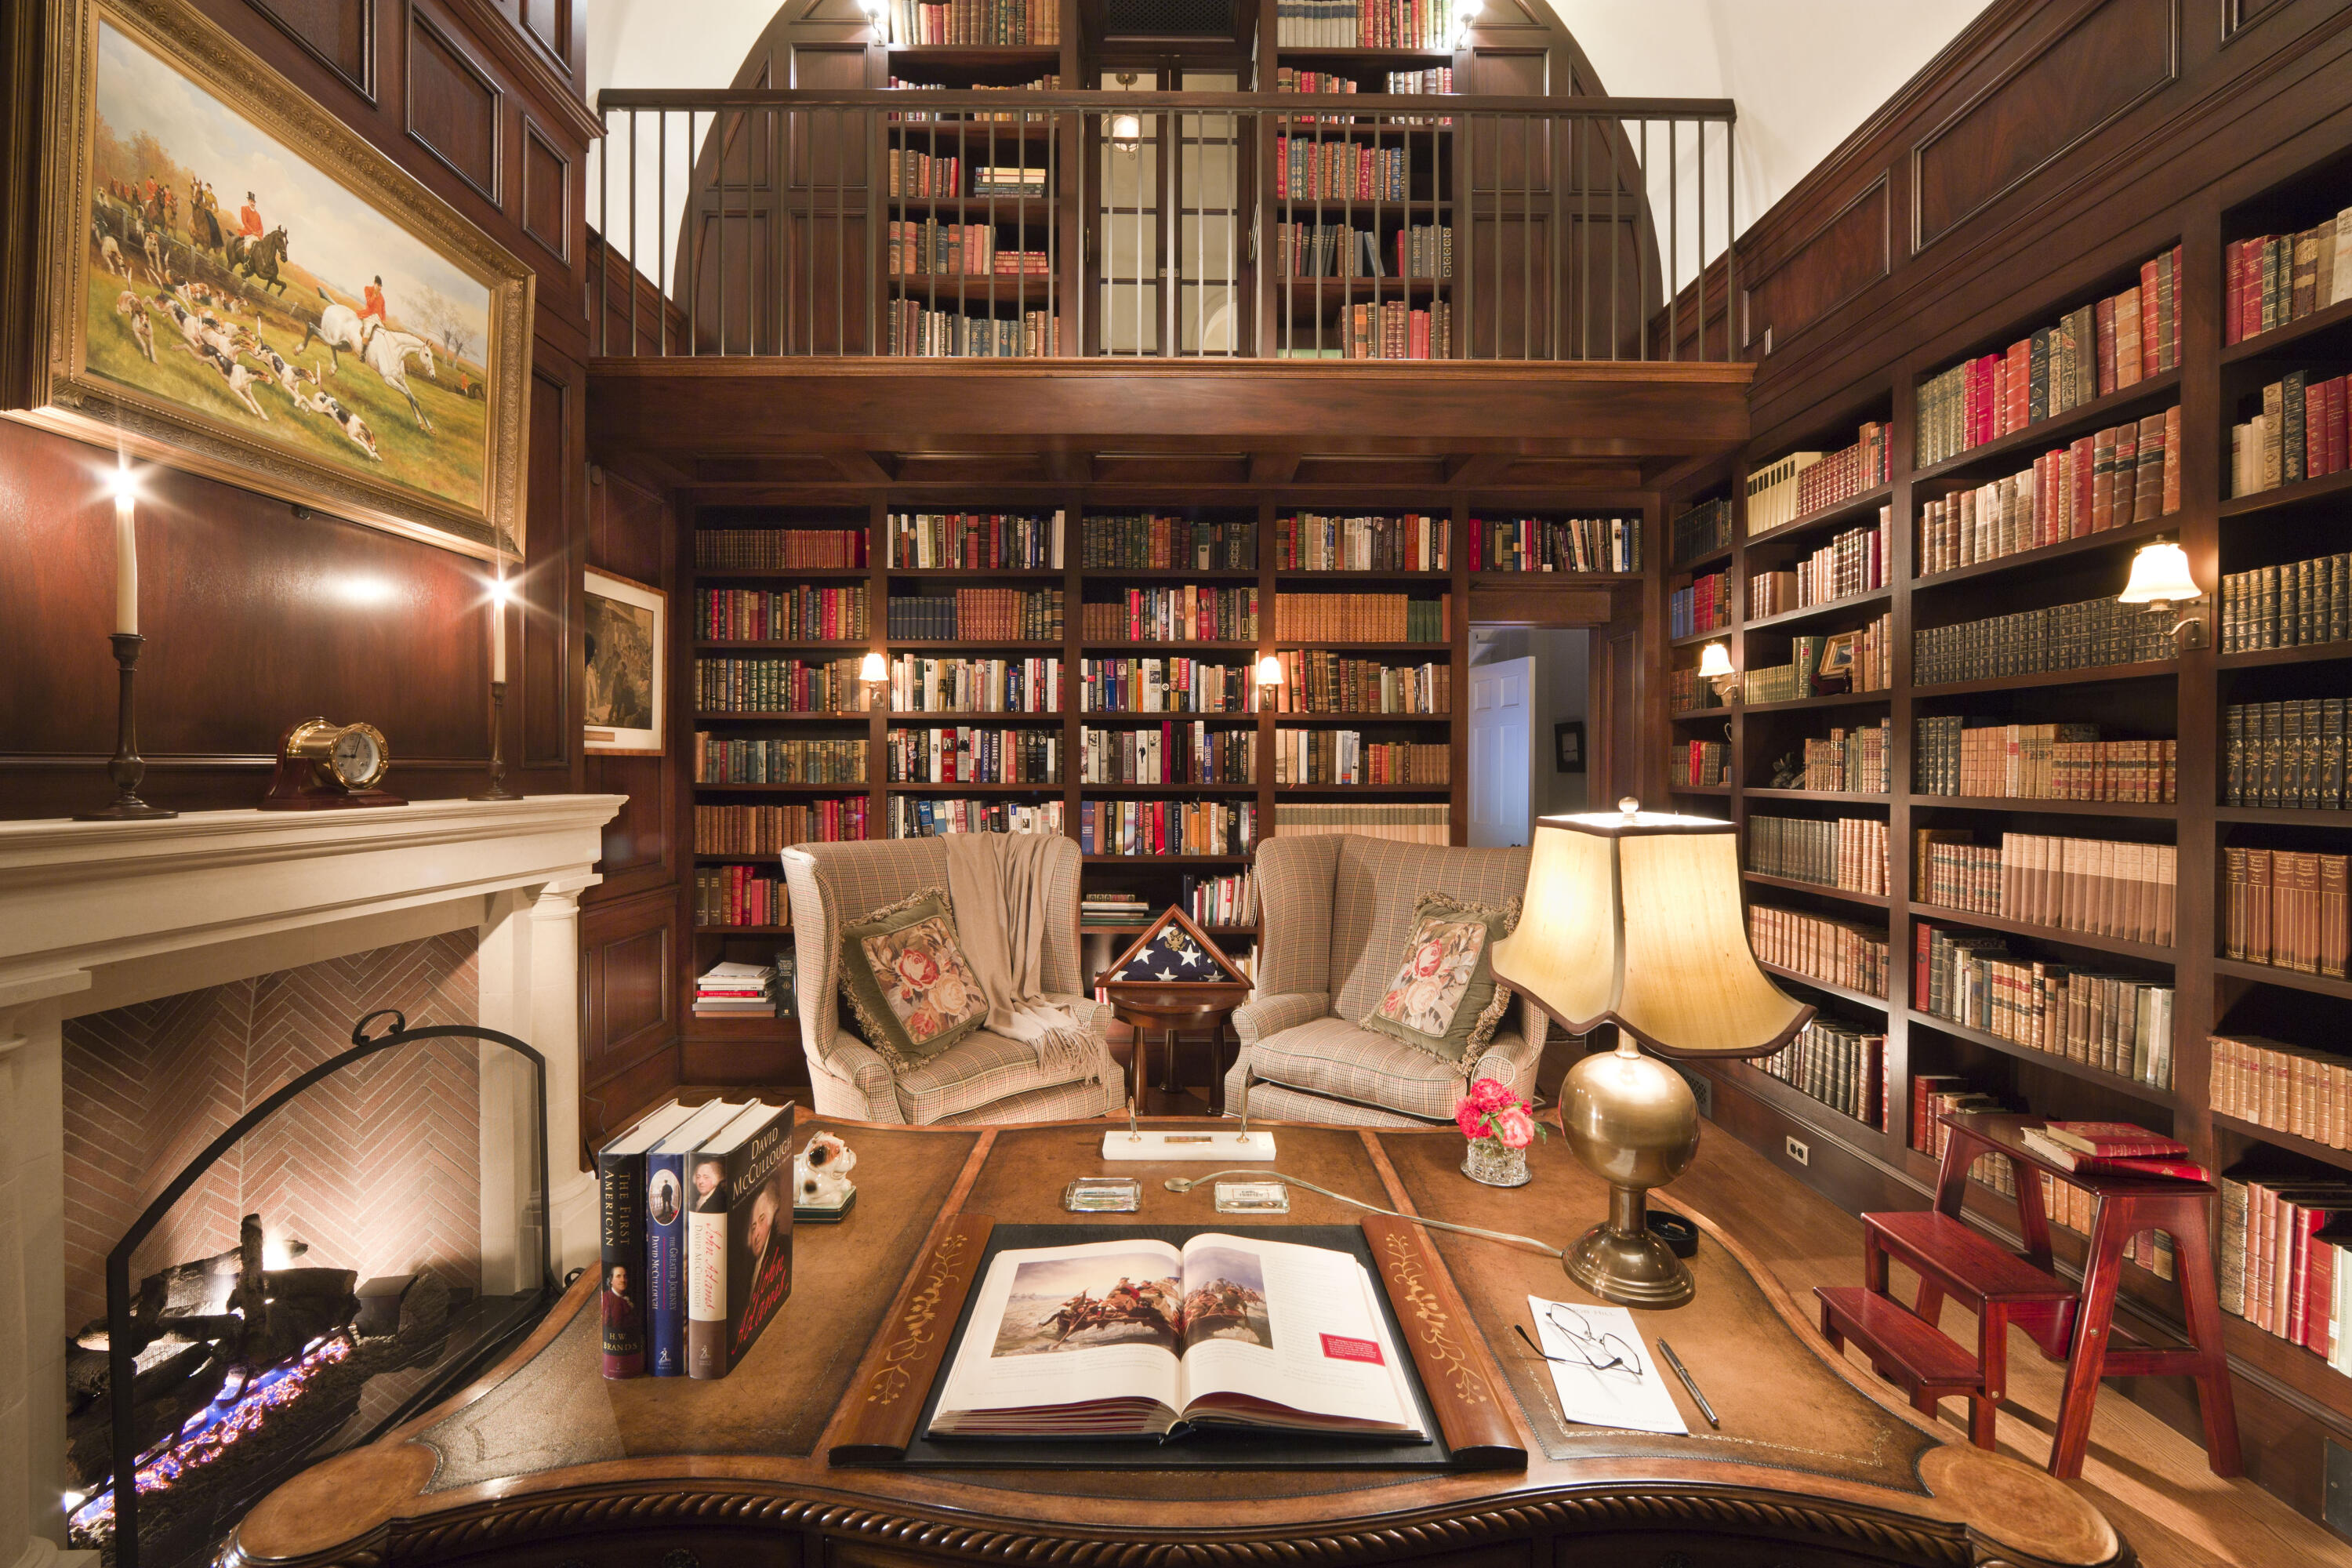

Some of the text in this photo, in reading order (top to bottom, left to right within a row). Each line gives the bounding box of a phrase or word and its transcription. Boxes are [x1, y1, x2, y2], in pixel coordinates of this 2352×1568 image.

[751, 1127, 779, 1160] DAVID
[604, 1170, 615, 1247] AMERICAN
[619, 1173, 631, 1244] THE FIRST
[652, 1236, 660, 1258] DAVID
[694, 1225, 703, 1250] DAVID
[706, 1222, 723, 1256] John
[669, 1247, 678, 1280] GREATER
[752, 1246, 784, 1303] John
[669, 1280, 678, 1310] JOURNEY
[603, 1341, 637, 1351] BRANDS
